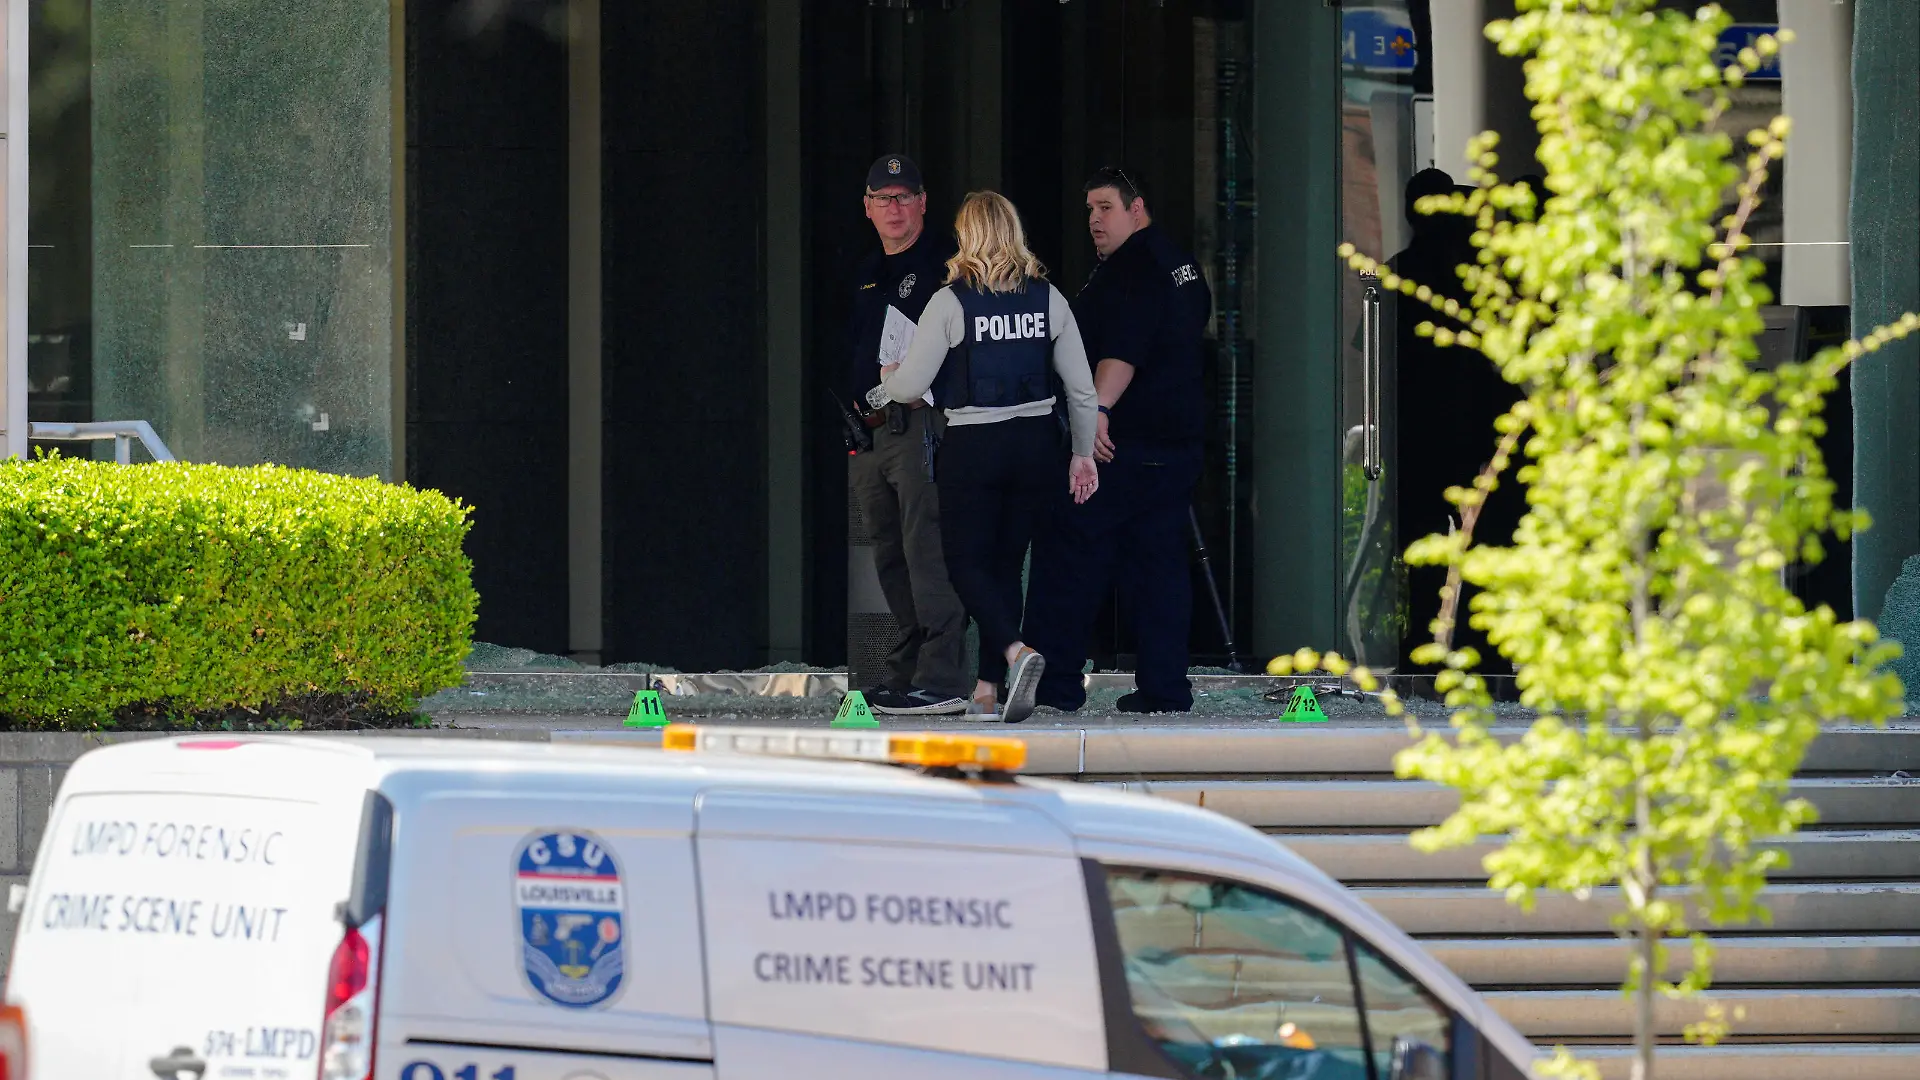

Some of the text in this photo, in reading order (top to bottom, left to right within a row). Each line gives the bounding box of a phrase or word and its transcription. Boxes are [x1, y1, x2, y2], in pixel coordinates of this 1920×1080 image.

[975, 312, 1046, 342] POLICE
[641, 696, 660, 716] 11
[1287, 694, 1302, 713] 12
[1303, 698, 1316, 712] 12
[71, 821, 283, 866] LMPD FORENSIC
[527, 833, 605, 869] CSU
[520, 885, 616, 904] LOUISVILLE
[768, 890, 1013, 930] LMPD FORENSIC
[43, 893, 288, 942] CRIME SCENE UNIT
[753, 951, 1035, 992] CRIME SCENE UNIT
